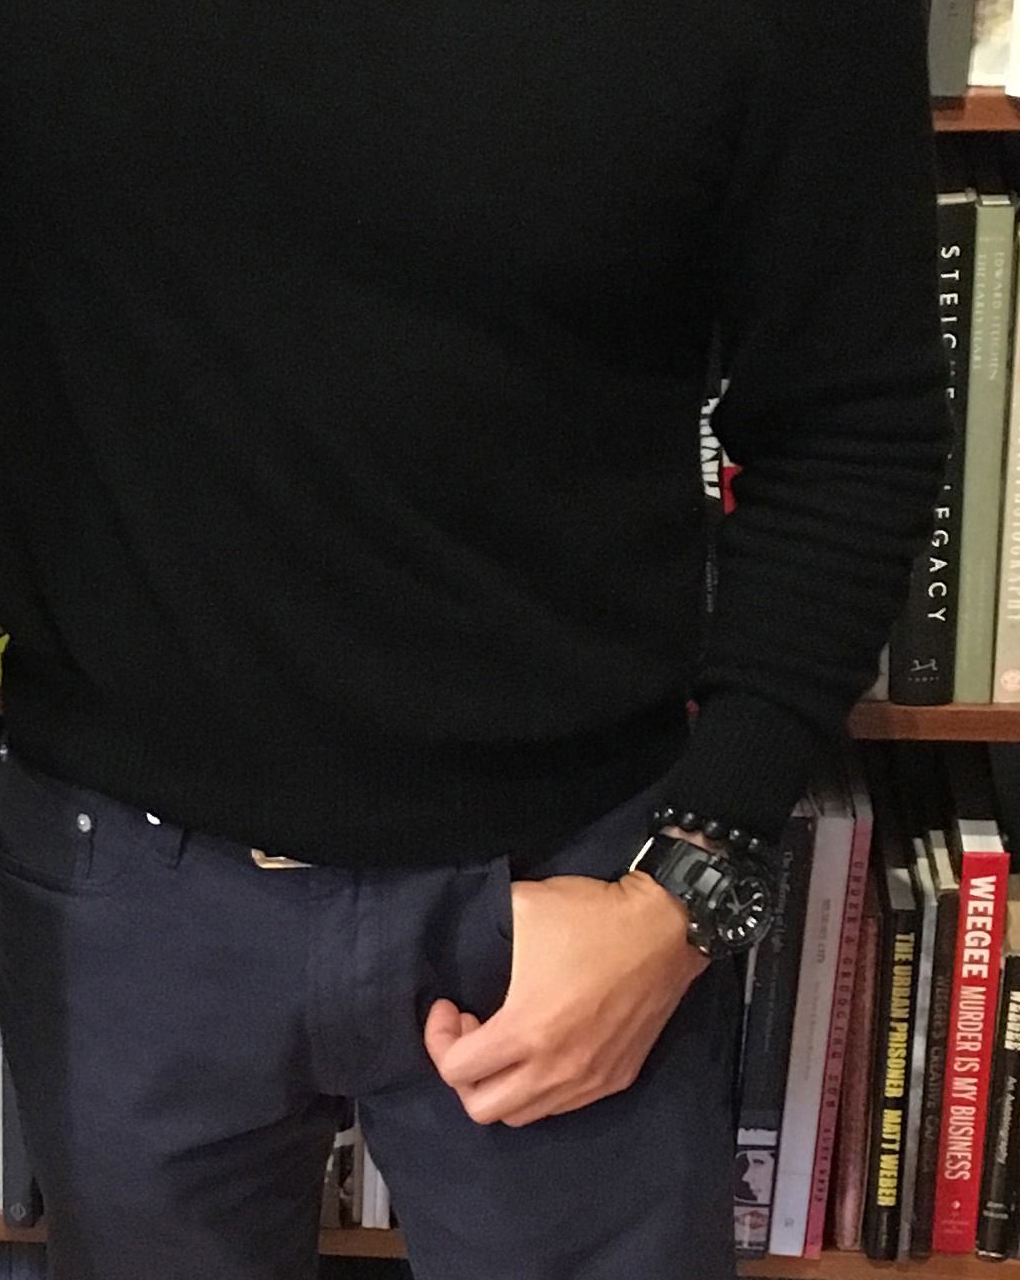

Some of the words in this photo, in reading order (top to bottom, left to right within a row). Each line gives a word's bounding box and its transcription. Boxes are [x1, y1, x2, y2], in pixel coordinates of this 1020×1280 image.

[894, 932, 916, 961] THE
[962, 875, 997, 978] WEEGEE
[889, 964, 914, 1019] URBAN
[955, 985, 987, 1052] MURDER
[883, 1021, 910, 1098] PRISONER
[953, 1057, 980, 1072] IS
[1007, 1076, 1017, 1090] An
[950, 1077, 979, 1101] MY
[882, 1109, 903, 1152] MATT
[943, 1105, 977, 1181] BUSINESS
[996, 1092, 1015, 1165] Autobiography
[877, 1153, 899, 1207] WEBER
